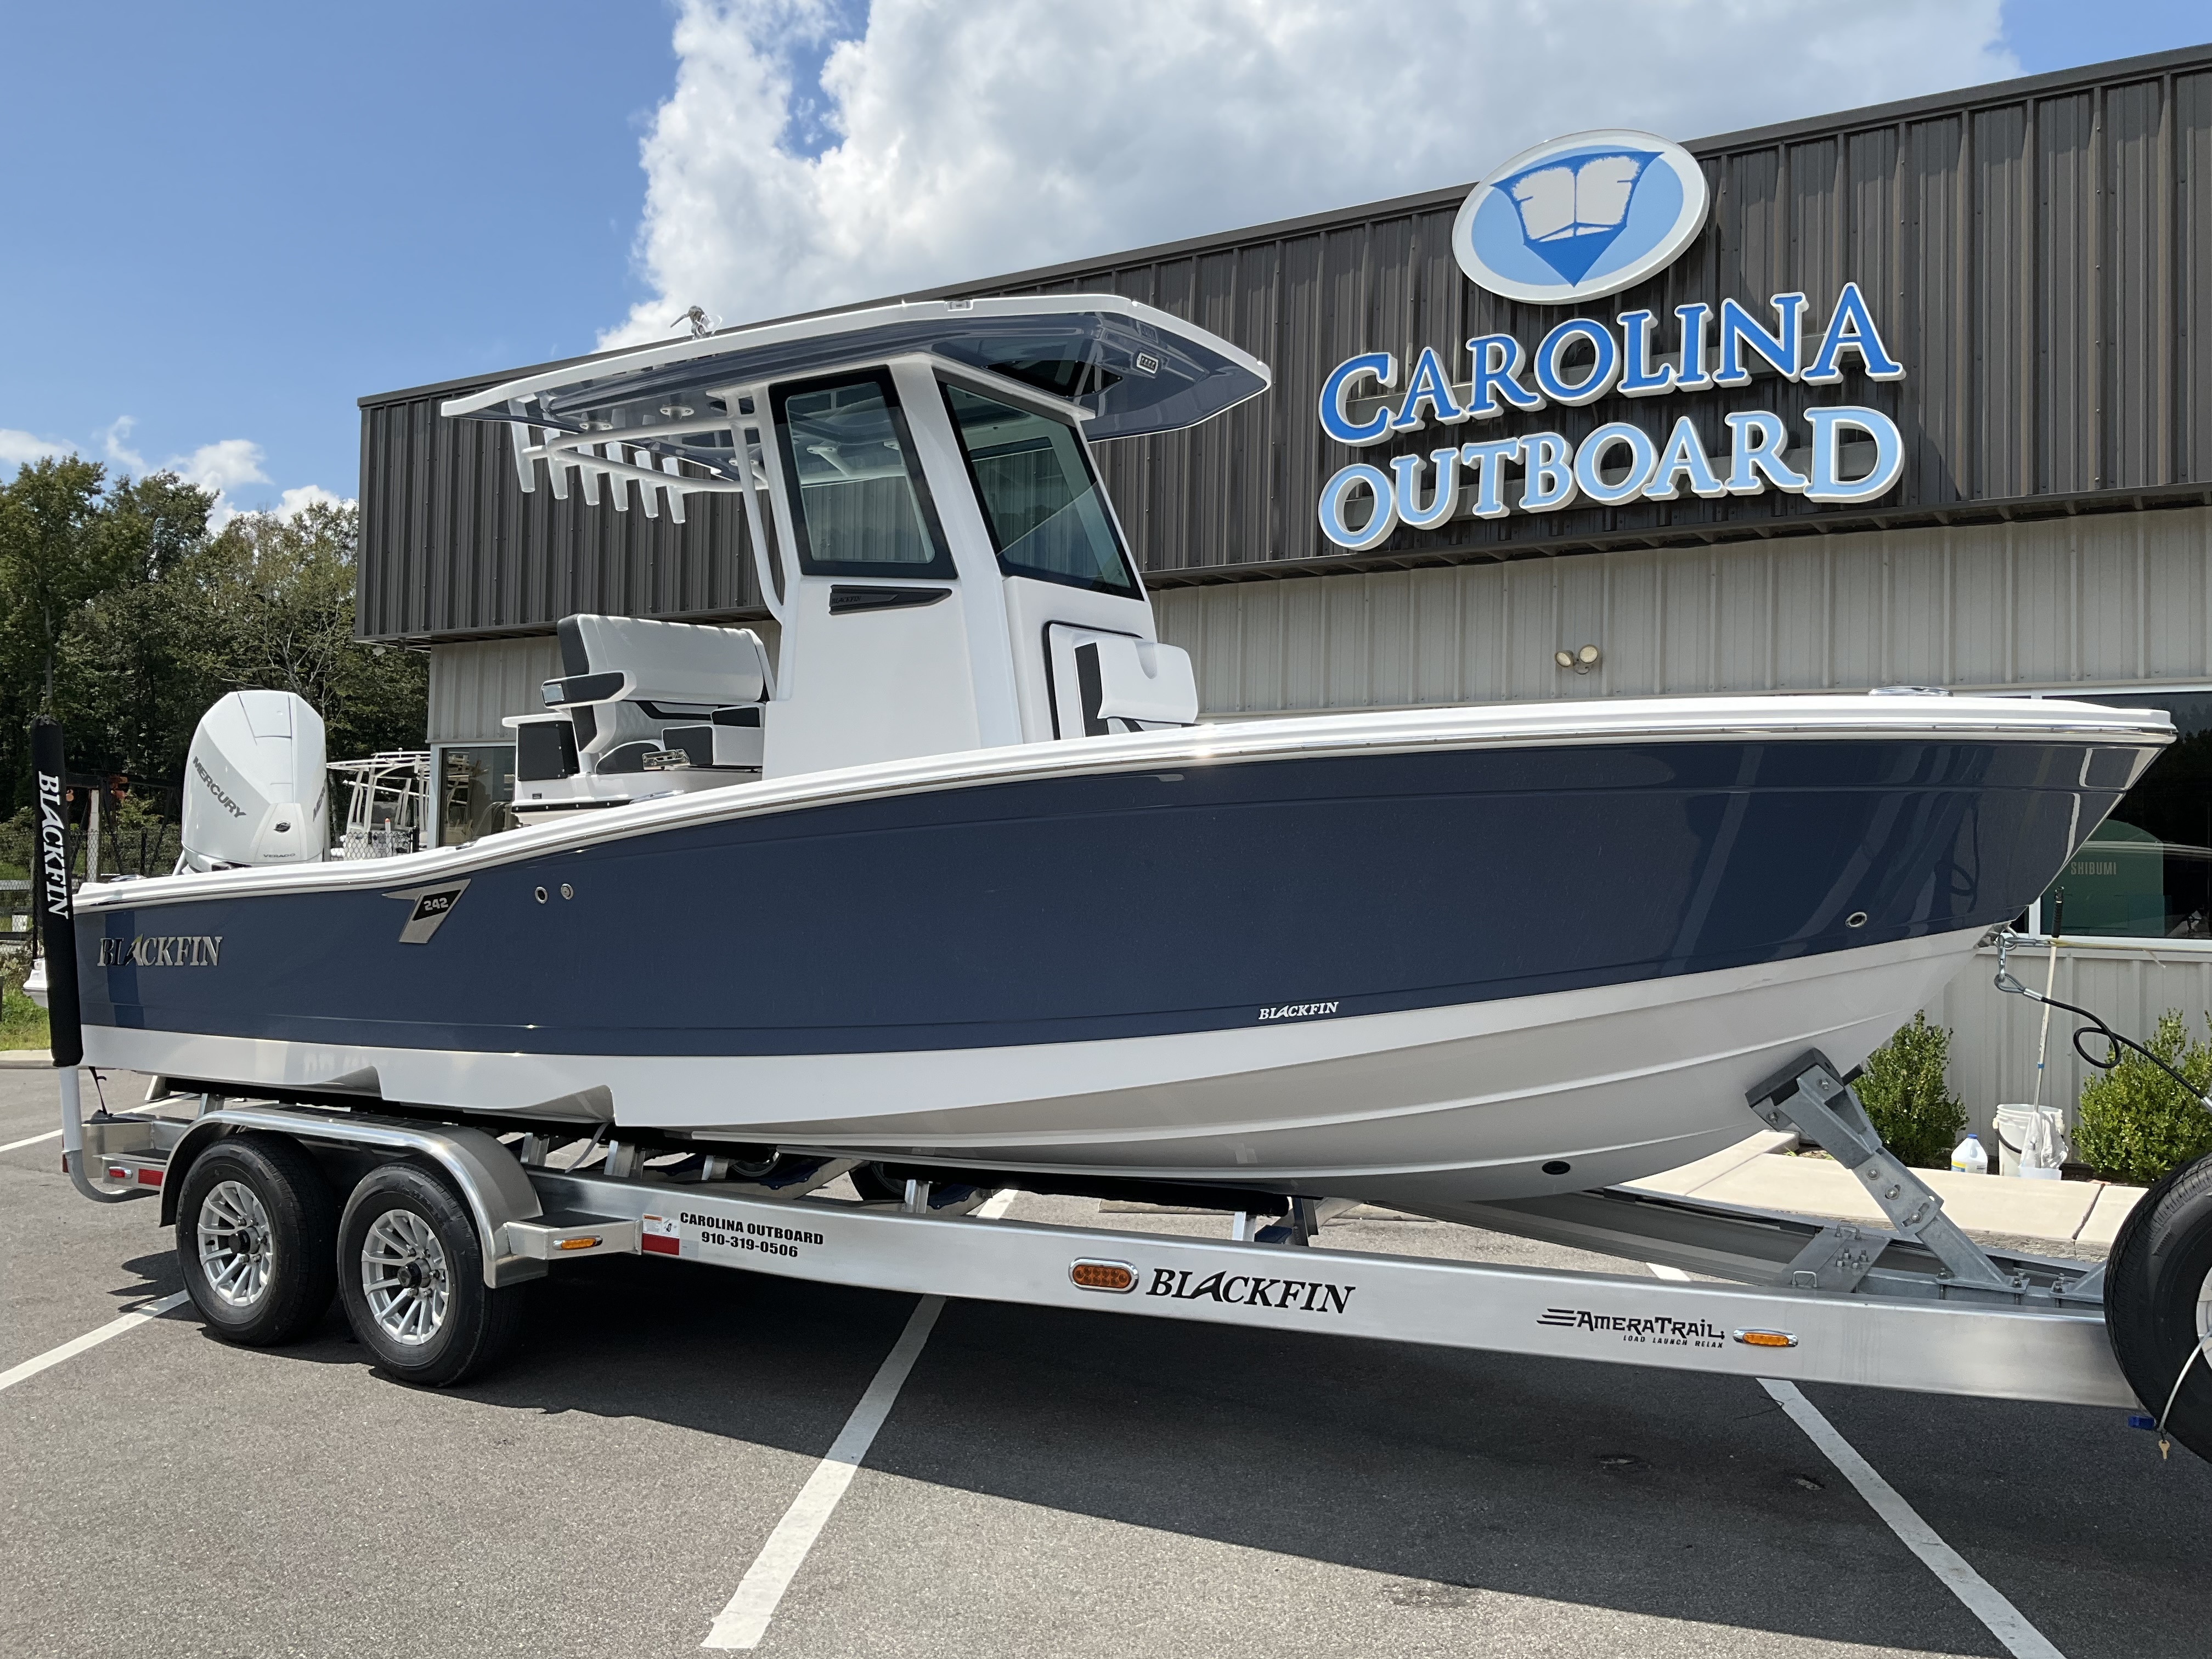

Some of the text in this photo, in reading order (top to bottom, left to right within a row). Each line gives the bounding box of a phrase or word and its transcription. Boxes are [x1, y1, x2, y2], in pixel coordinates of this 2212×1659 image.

[1319, 282, 1906, 447] CAROLINA
[1318, 406, 1905, 551] OUTBOARD
[831, 595, 862, 603] BLACKFIN
[193, 756, 246, 818] MERCURY
[38, 771, 69, 919] BLACKFIN
[2070, 861, 2117, 875] SHIBUMI
[424, 897, 449, 911] 242
[97, 933, 223, 966] BLACKFIN
[1258, 1002, 1339, 1020] BLACKFIN
[680, 1212, 744, 1233] CAROLINA
[747, 1223, 823, 1245] OUTBOARD
[701, 1231, 798, 1257] 910-319-0506
[1146, 1268, 1356, 1314] BLACKFIN
[1623, 1335, 1723, 1348] LOAD LAUNCH RELAX
